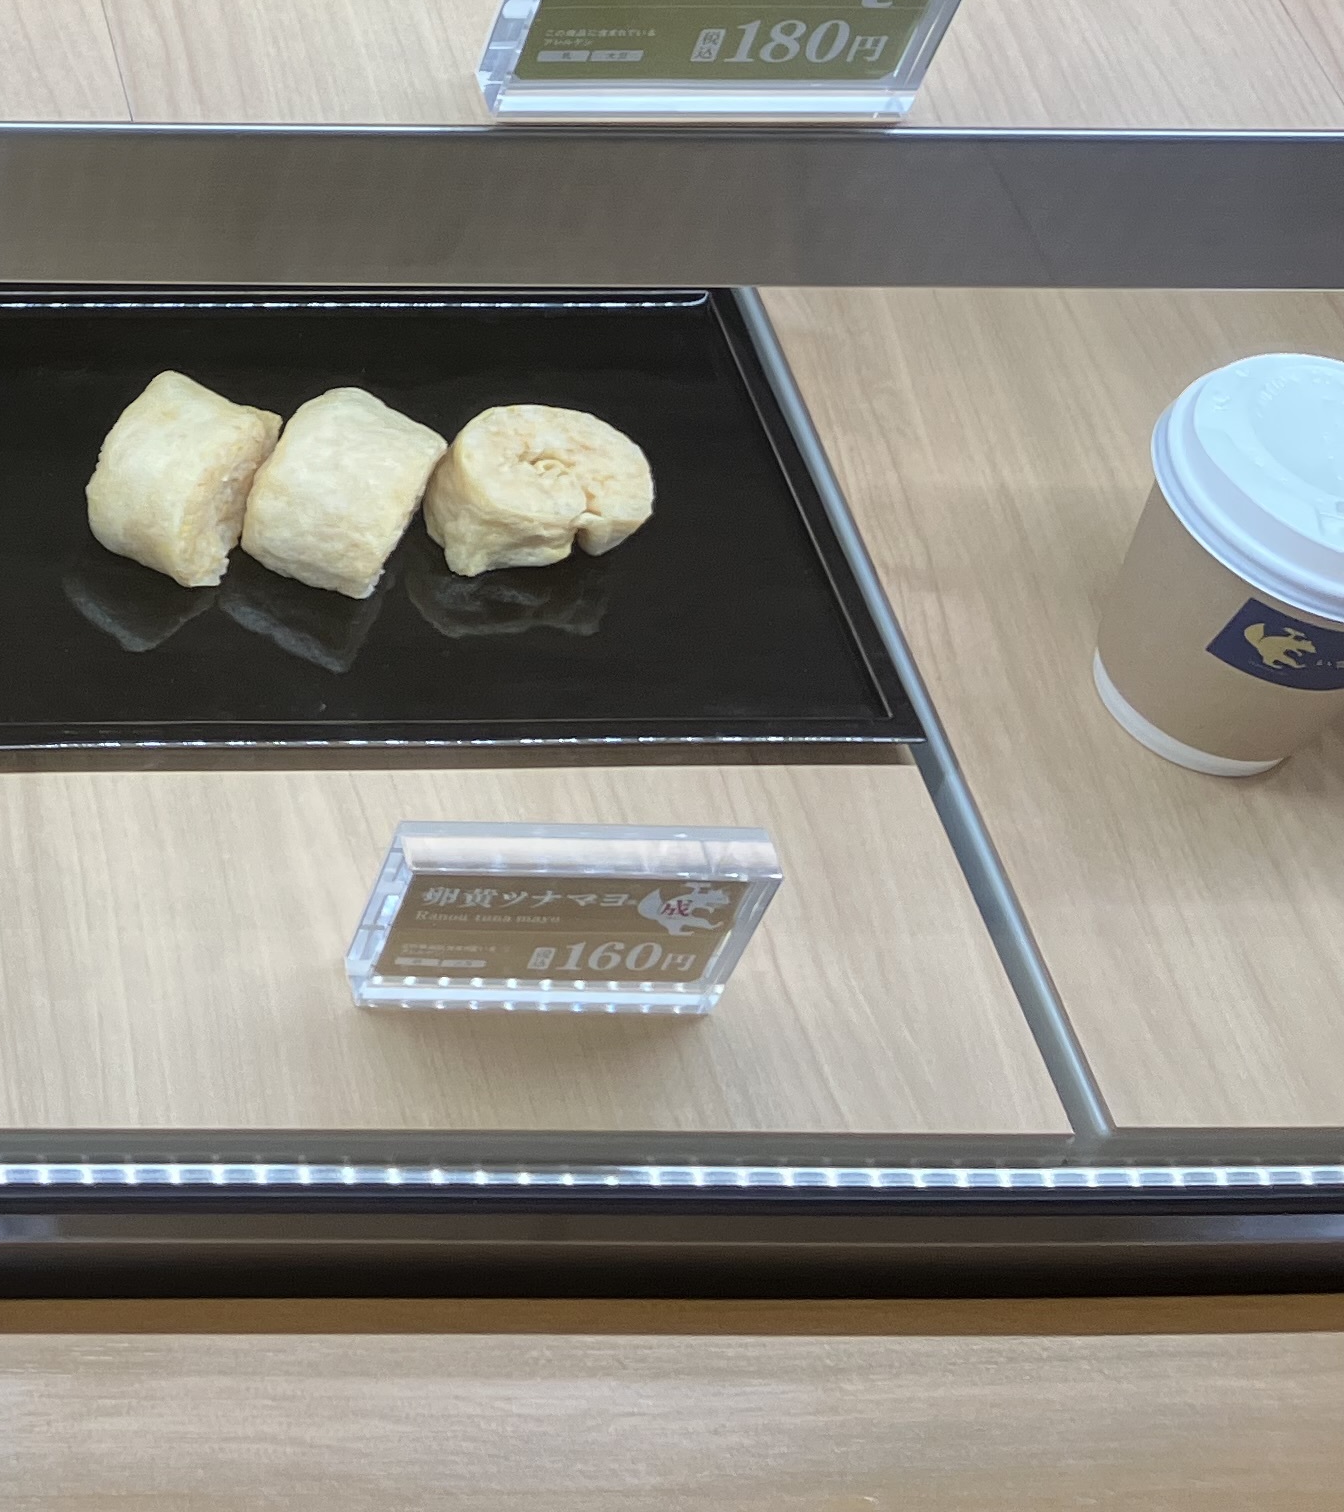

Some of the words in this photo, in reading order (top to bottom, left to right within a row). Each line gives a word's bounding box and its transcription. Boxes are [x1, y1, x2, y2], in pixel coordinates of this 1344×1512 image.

[724, 19, 889, 63] 180円
[421, 887, 630, 908] 卵黄ツナマヨ
[556, 941, 696, 971] 160円
